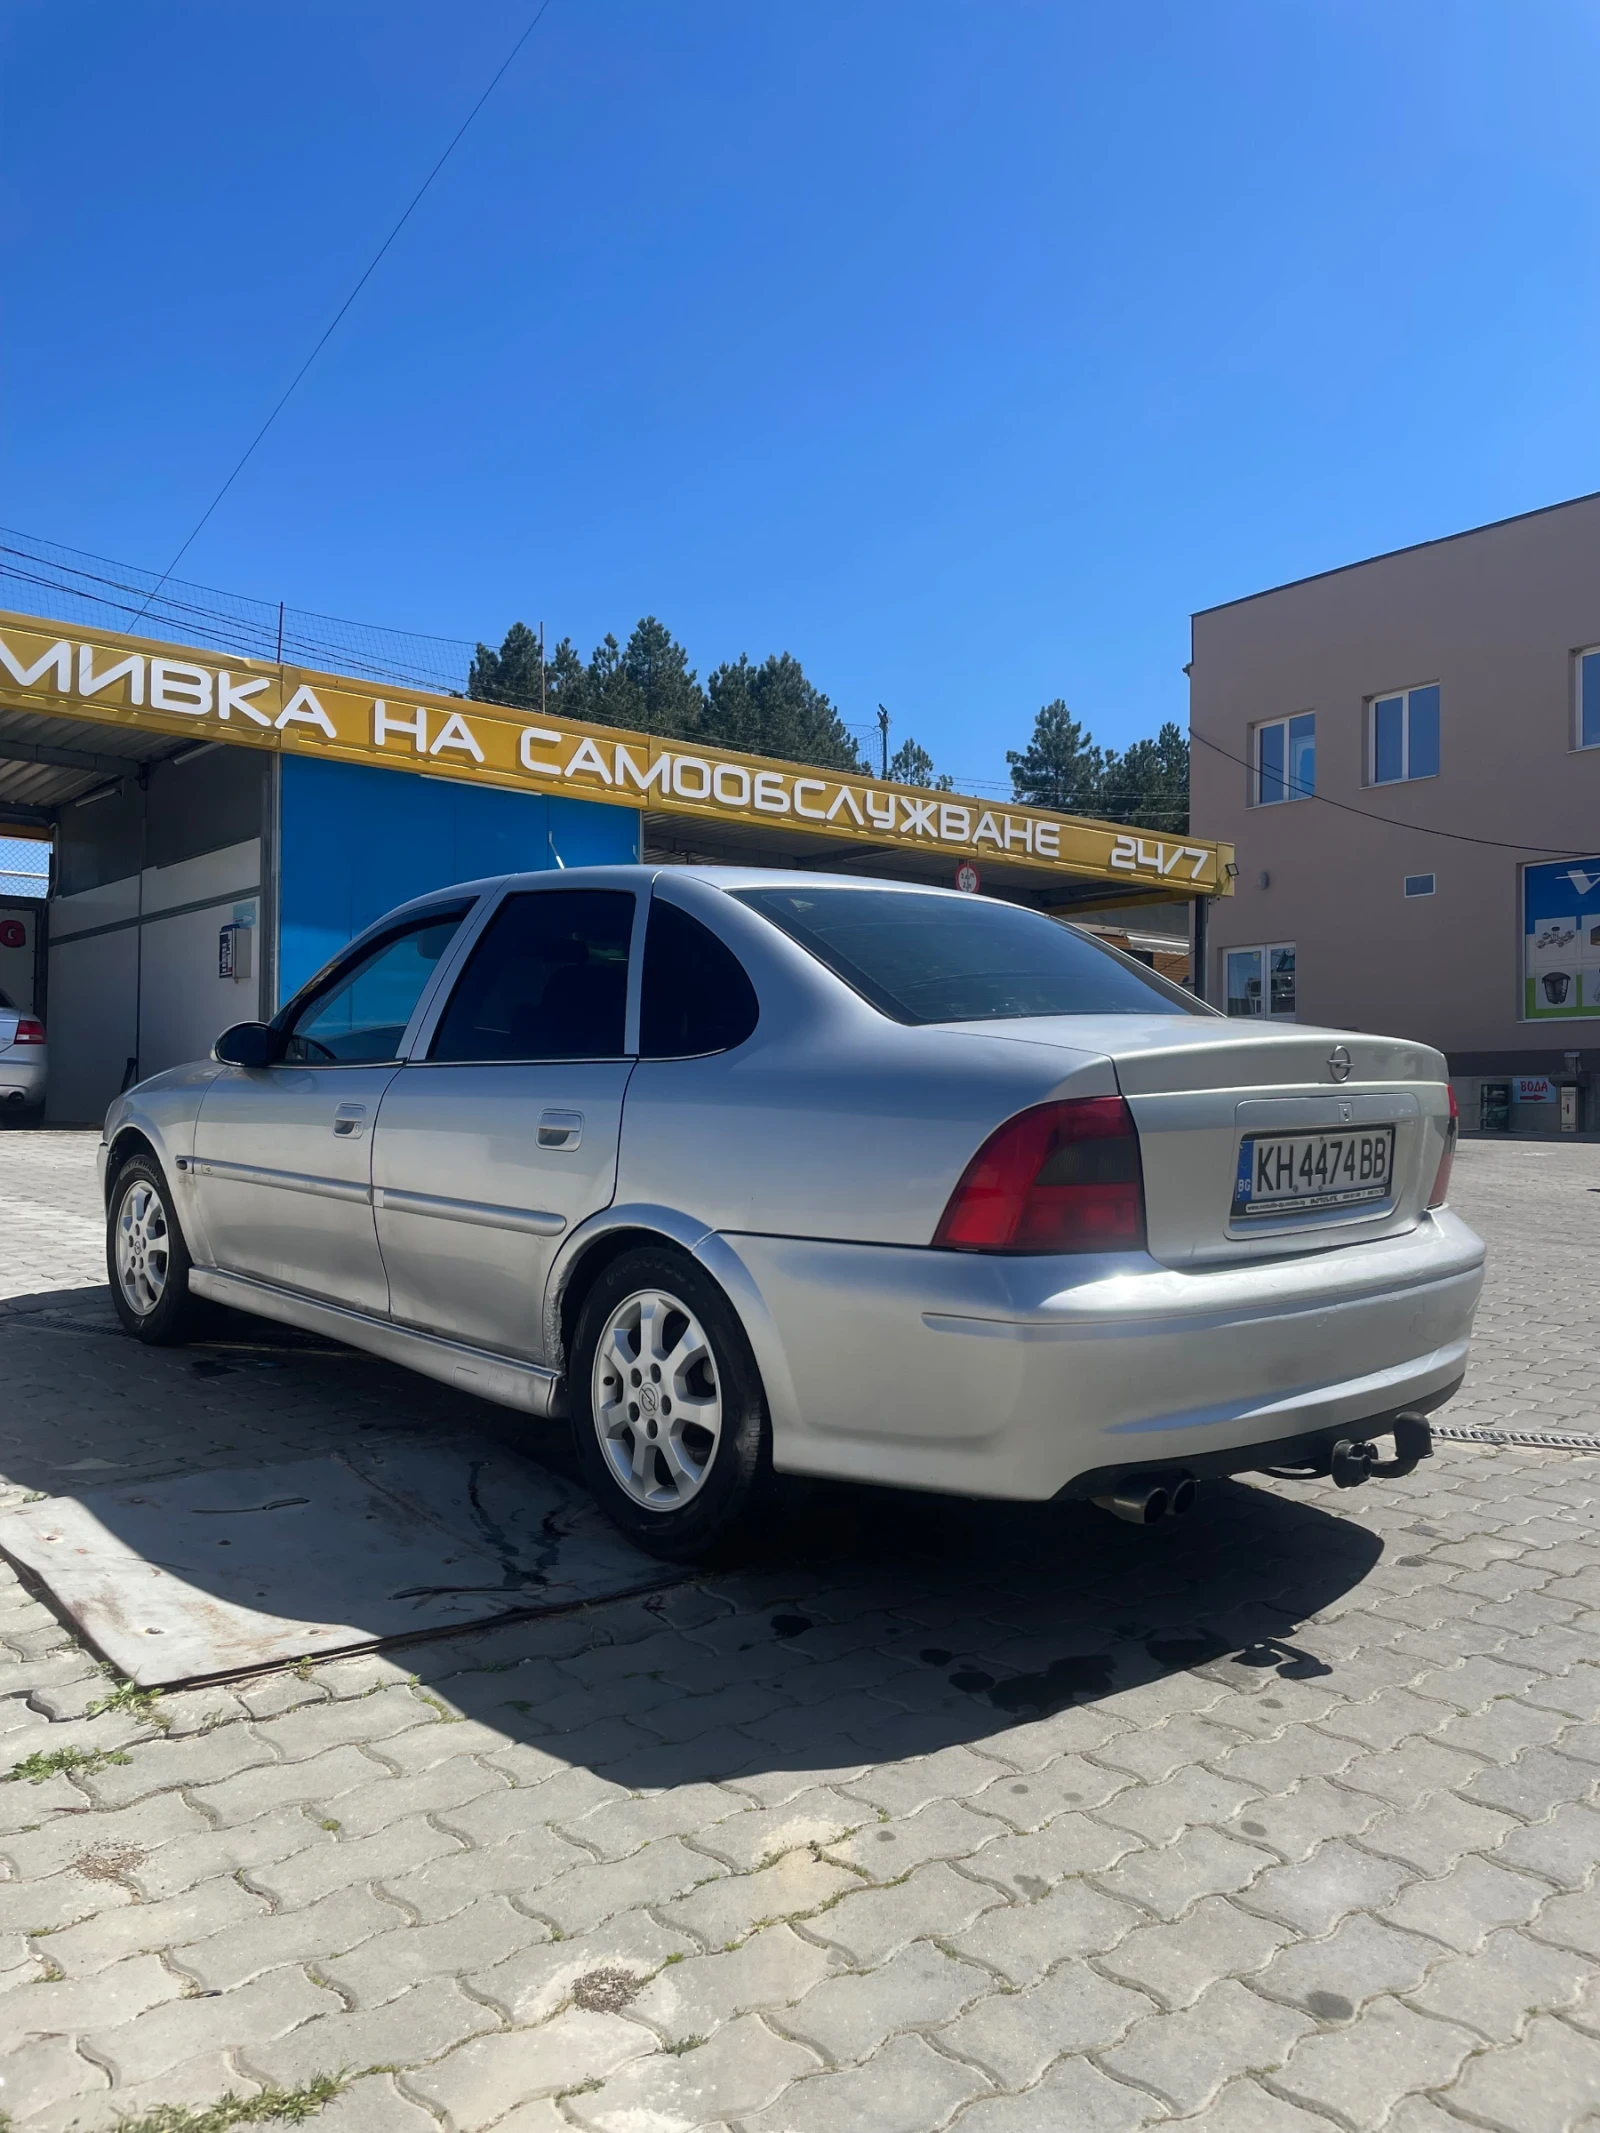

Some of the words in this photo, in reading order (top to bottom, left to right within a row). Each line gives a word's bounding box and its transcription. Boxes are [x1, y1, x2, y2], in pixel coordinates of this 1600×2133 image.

[0, 637, 337, 739] МИВКА
[374, 699, 485, 763] НА
[520, 728, 1060, 858] САМООБСЛУЖВАНЕ
[1111, 835, 1208, 879] 24/7
[1520, 1080, 1548, 1093] ВОДА
[1238, 1179, 1250, 1192] BG
